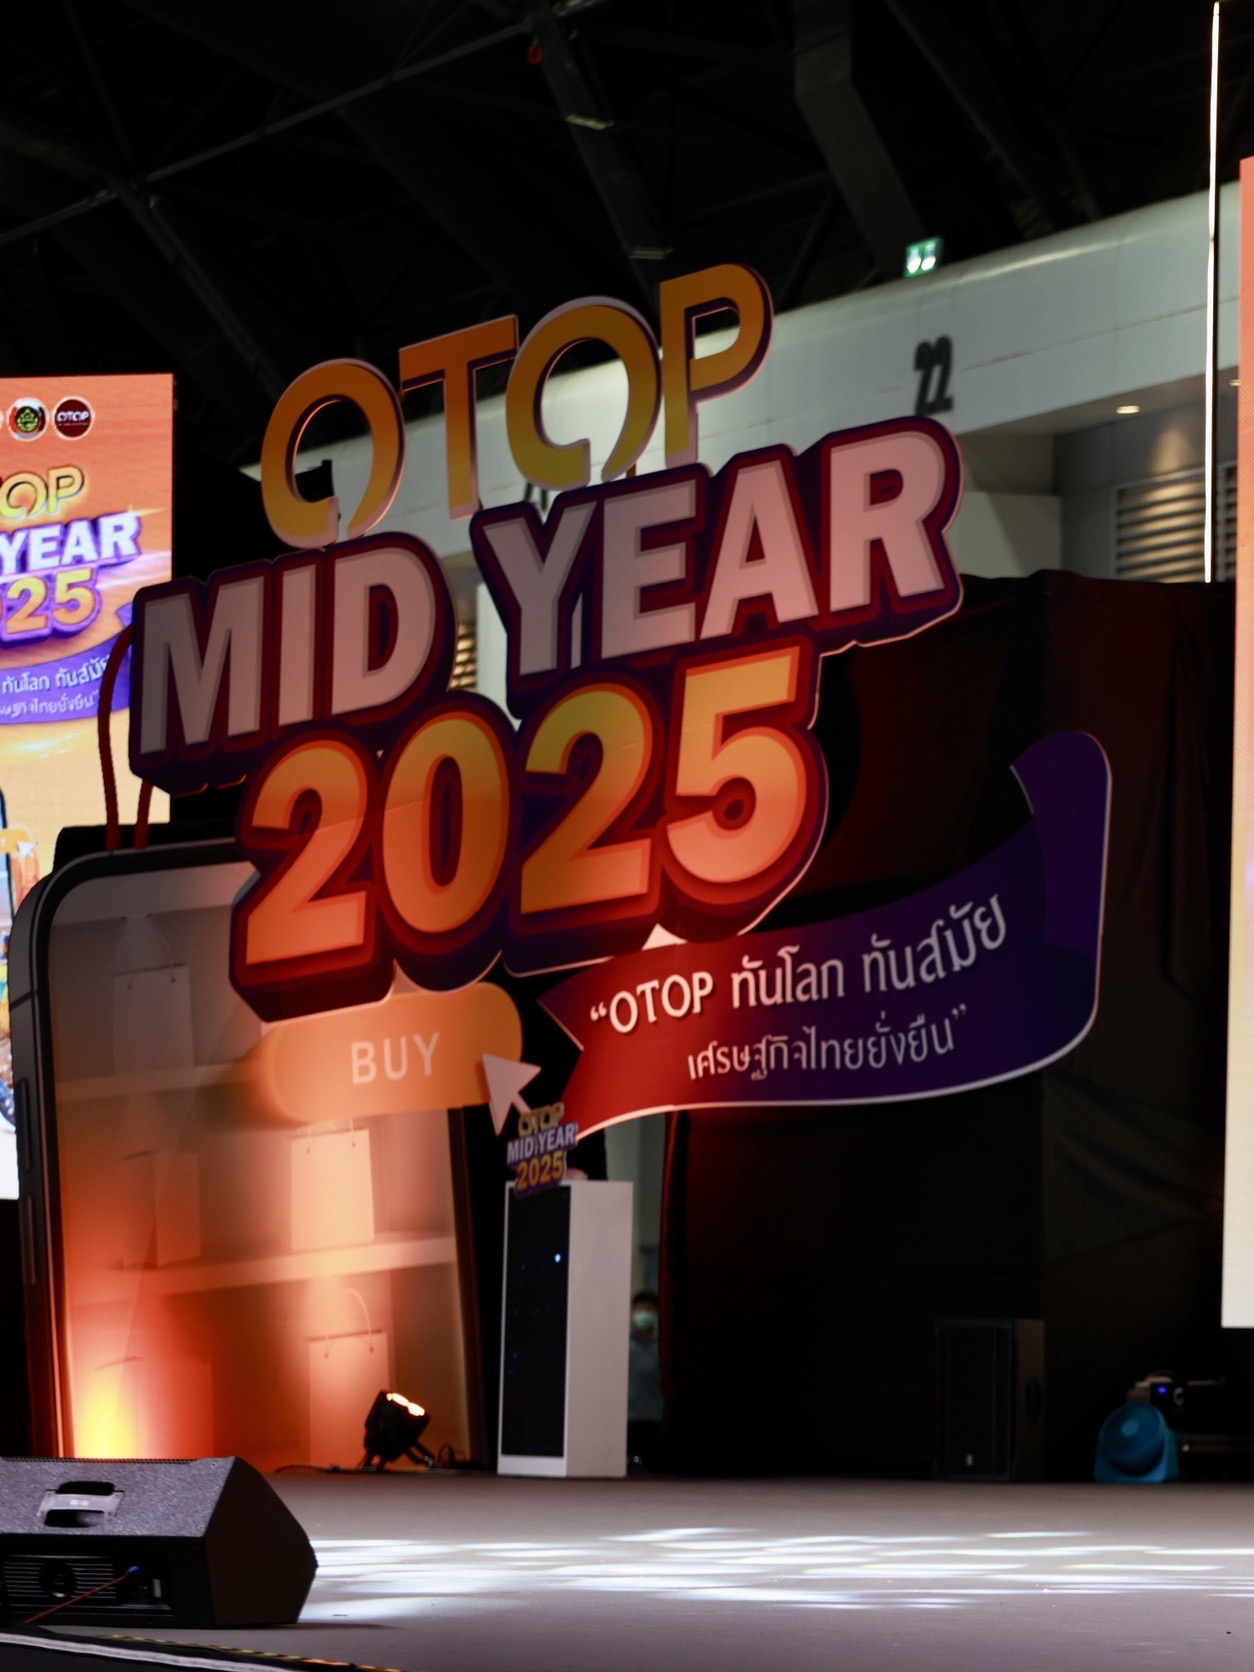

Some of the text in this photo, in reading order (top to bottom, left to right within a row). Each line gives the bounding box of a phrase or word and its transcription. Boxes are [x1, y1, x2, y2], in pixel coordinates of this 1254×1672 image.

[260, 263, 774, 548] OTOP
[913, 335, 954, 415] 22
[139, 430, 947, 753] MID YEAR
[246, 652, 807, 965] 2025
[731, 945, 844, 1009] ทันโลก
[862, 893, 1008, 993] ทันสมัย
[351, 1032, 440, 1085] BUY
[507, 1122, 575, 1165] MID YEAR
[517, 1150, 564, 1190] 2025
